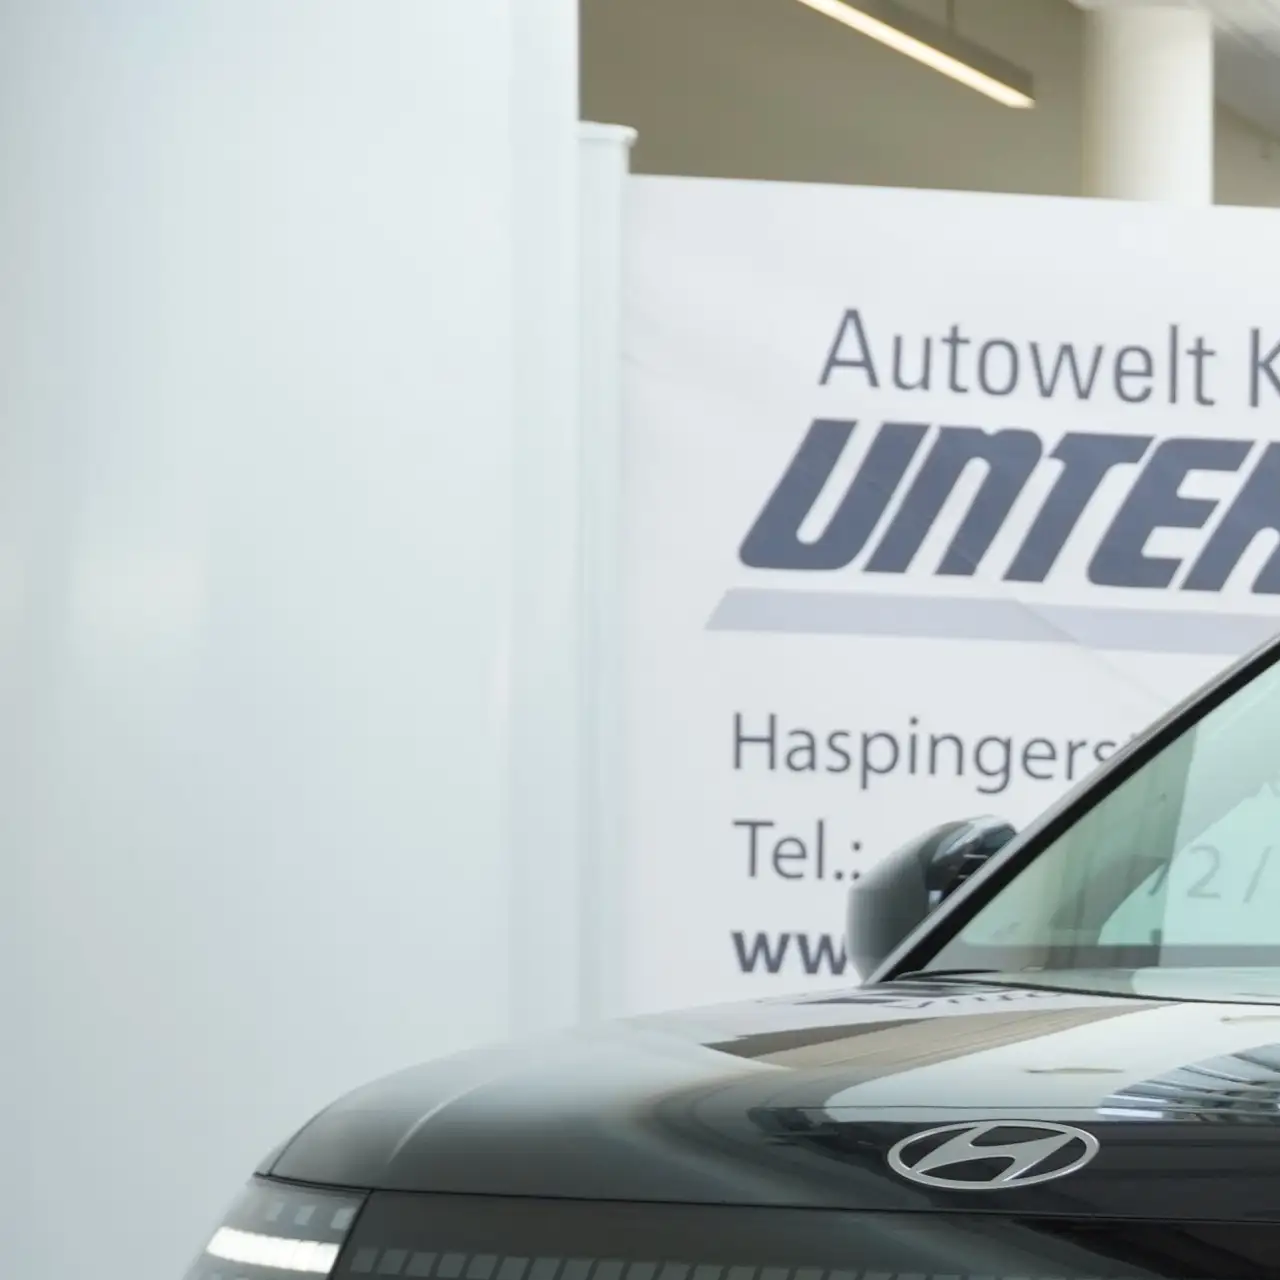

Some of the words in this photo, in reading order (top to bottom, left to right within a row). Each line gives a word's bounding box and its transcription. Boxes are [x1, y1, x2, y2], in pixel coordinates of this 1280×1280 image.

[819, 306, 1216, 407] Autowelt
[732, 818, 861, 881] Tel.:
[731, 931, 848, 976] ww
